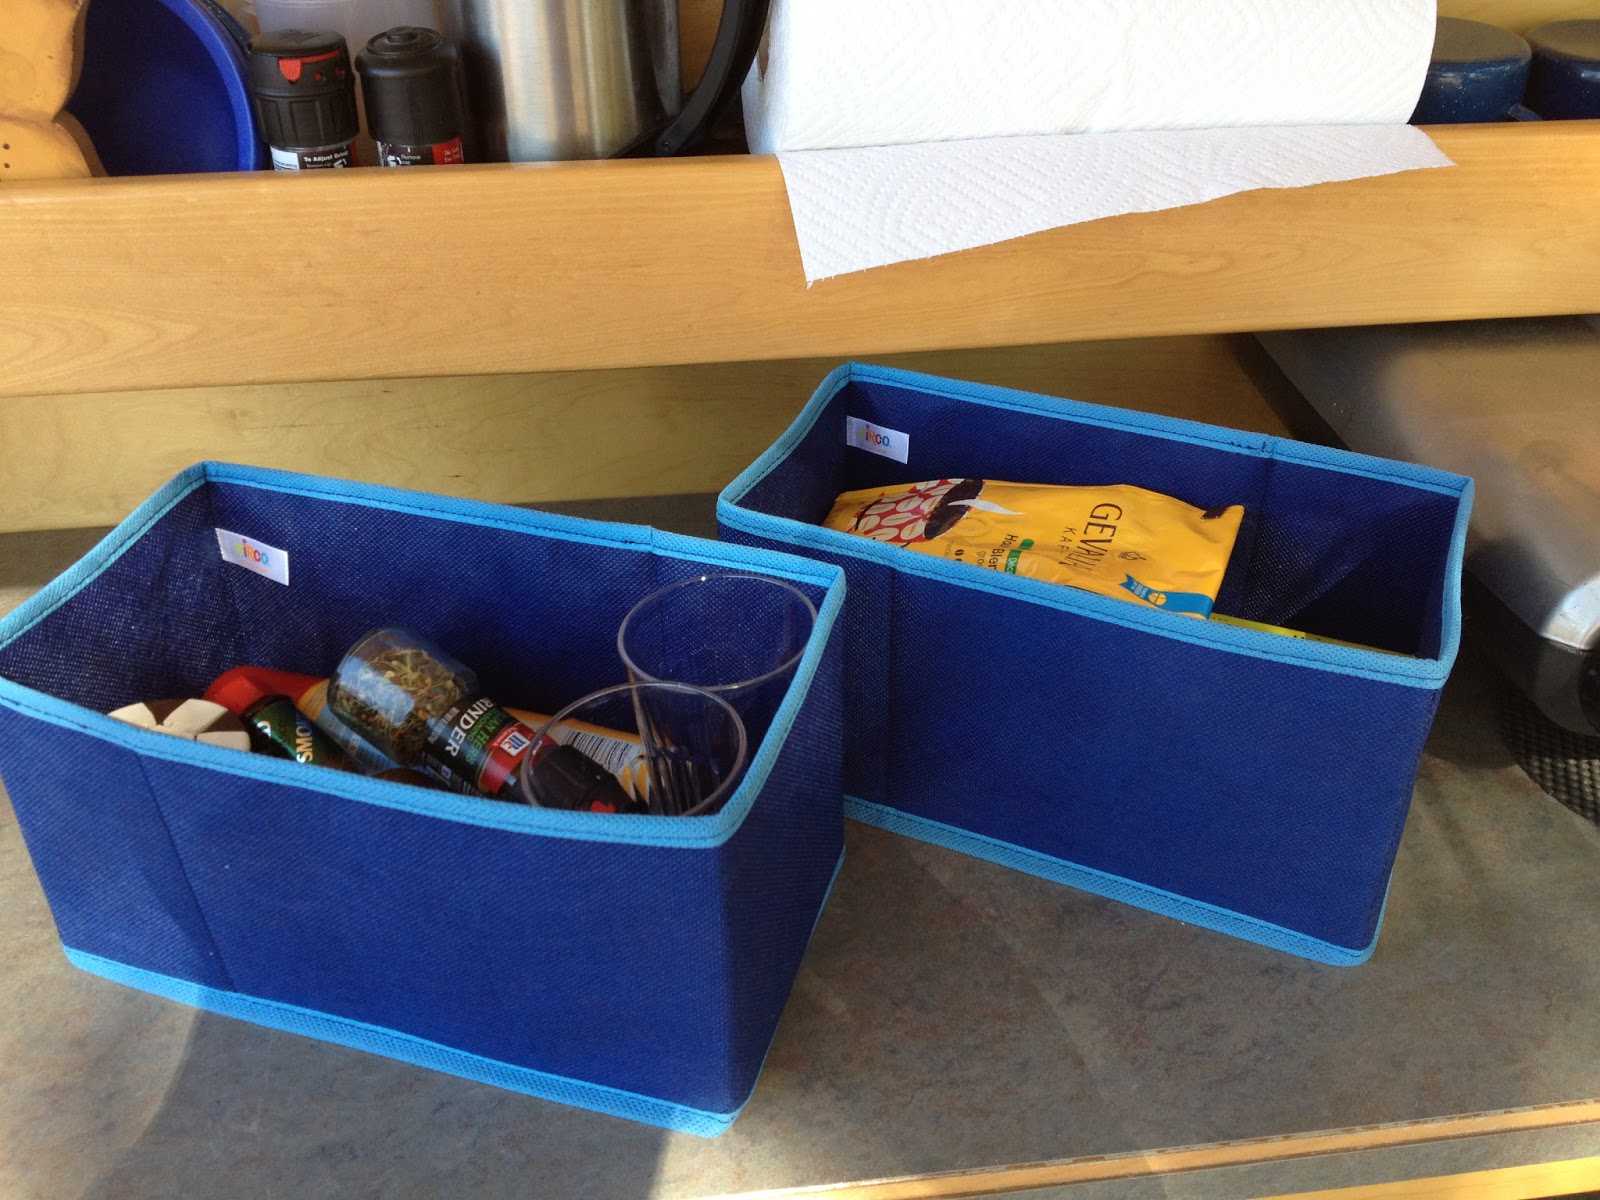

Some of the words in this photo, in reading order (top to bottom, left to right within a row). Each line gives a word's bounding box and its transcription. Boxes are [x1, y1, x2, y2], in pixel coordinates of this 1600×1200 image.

[1057, 526, 1077, 554] KAF
[977, 551, 986, 567] gro
[446, 698, 494, 757] RINDER
